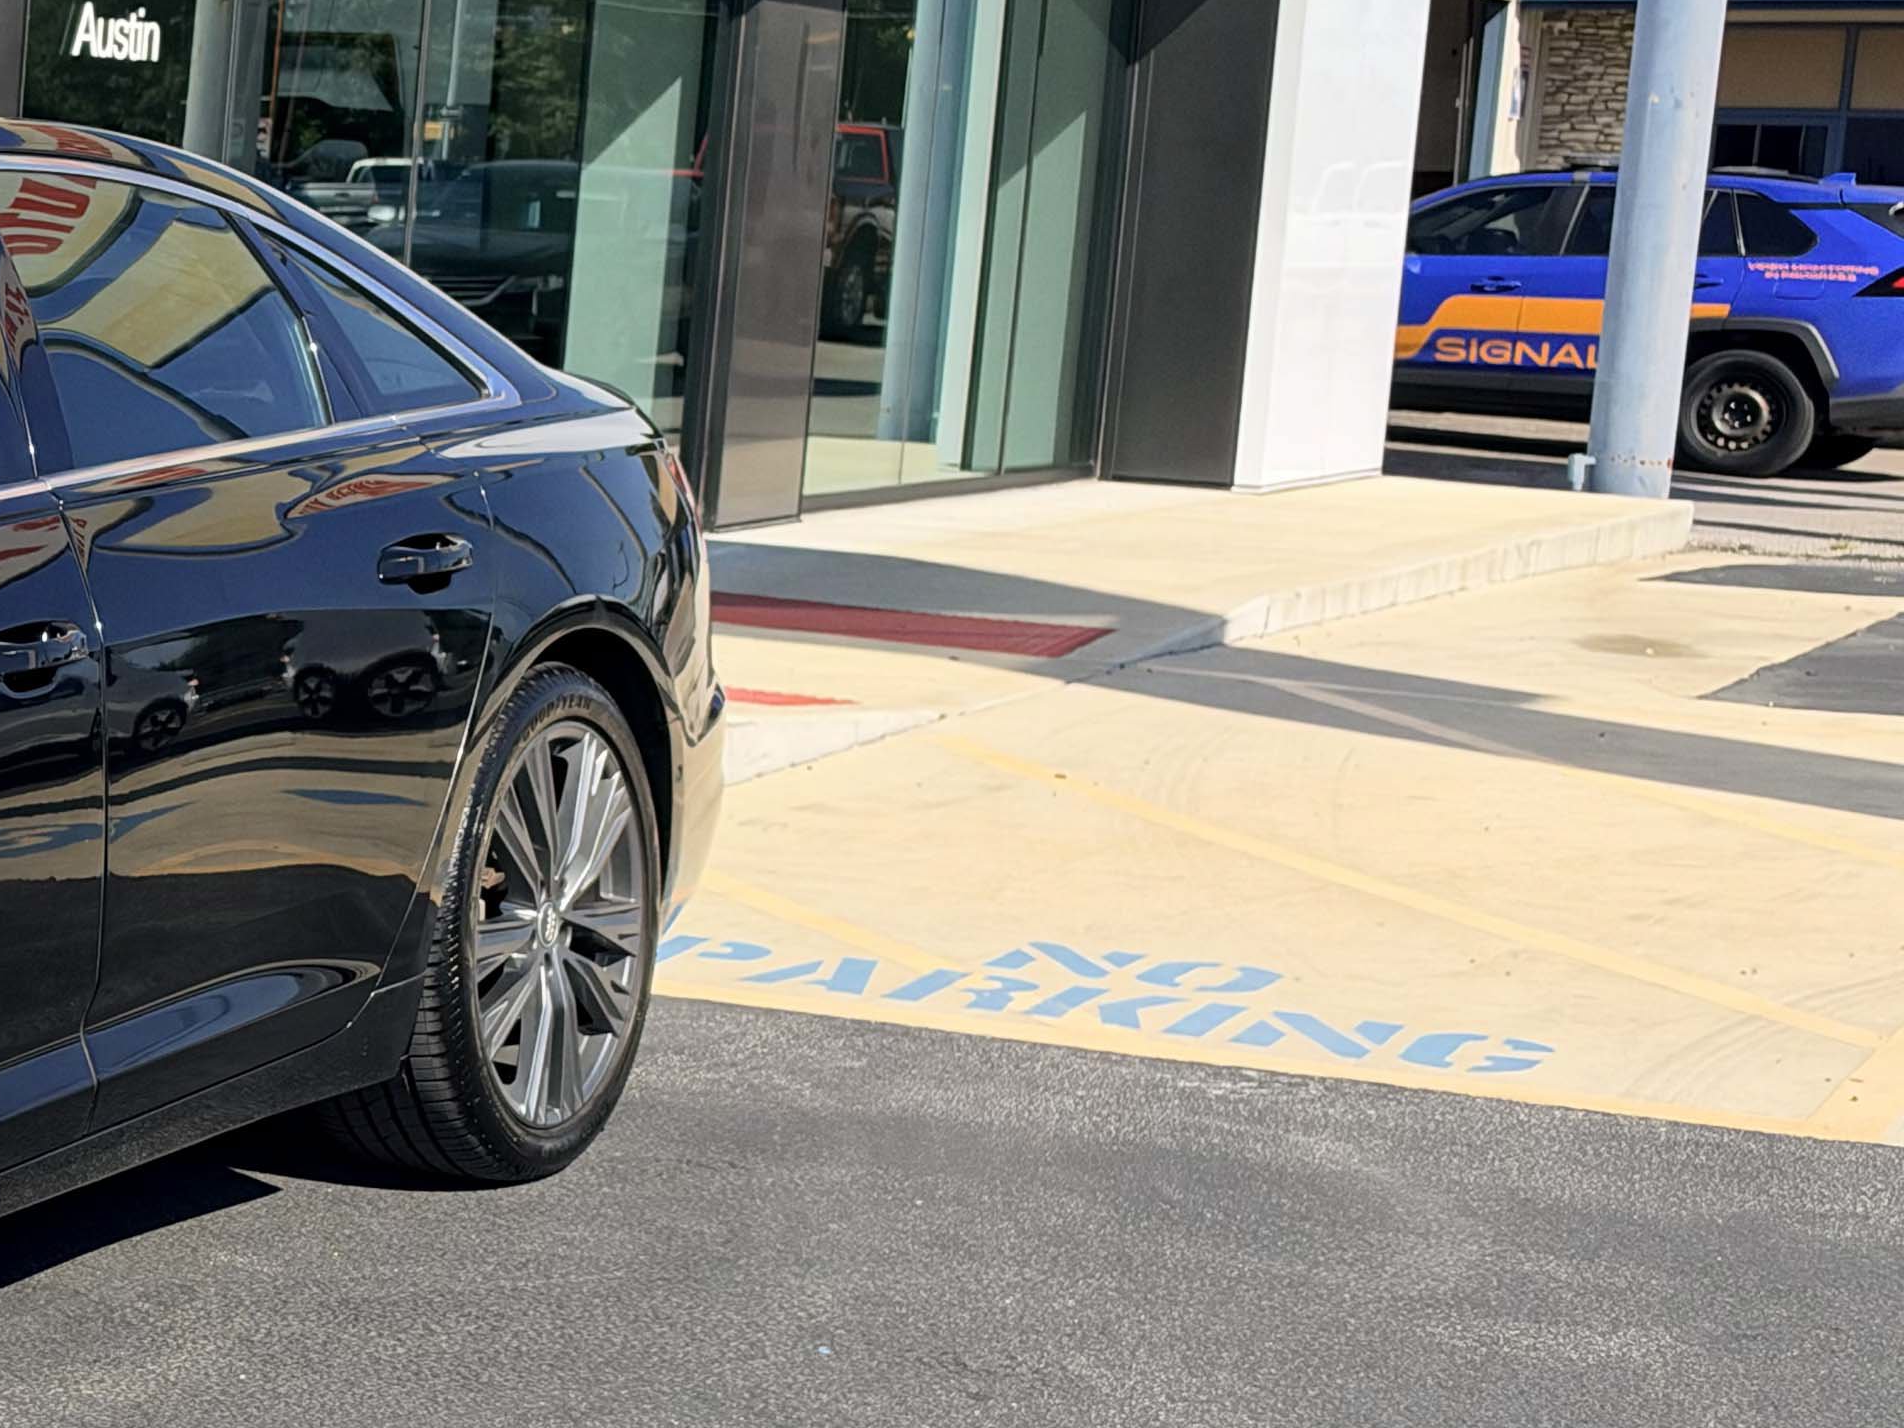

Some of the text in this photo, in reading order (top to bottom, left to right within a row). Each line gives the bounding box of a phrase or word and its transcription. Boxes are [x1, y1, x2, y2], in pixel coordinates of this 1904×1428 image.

[70, 1, 161, 63] Austin
[985, 940, 1285, 994] NO
[654, 935, 1556, 1074] PARKING
